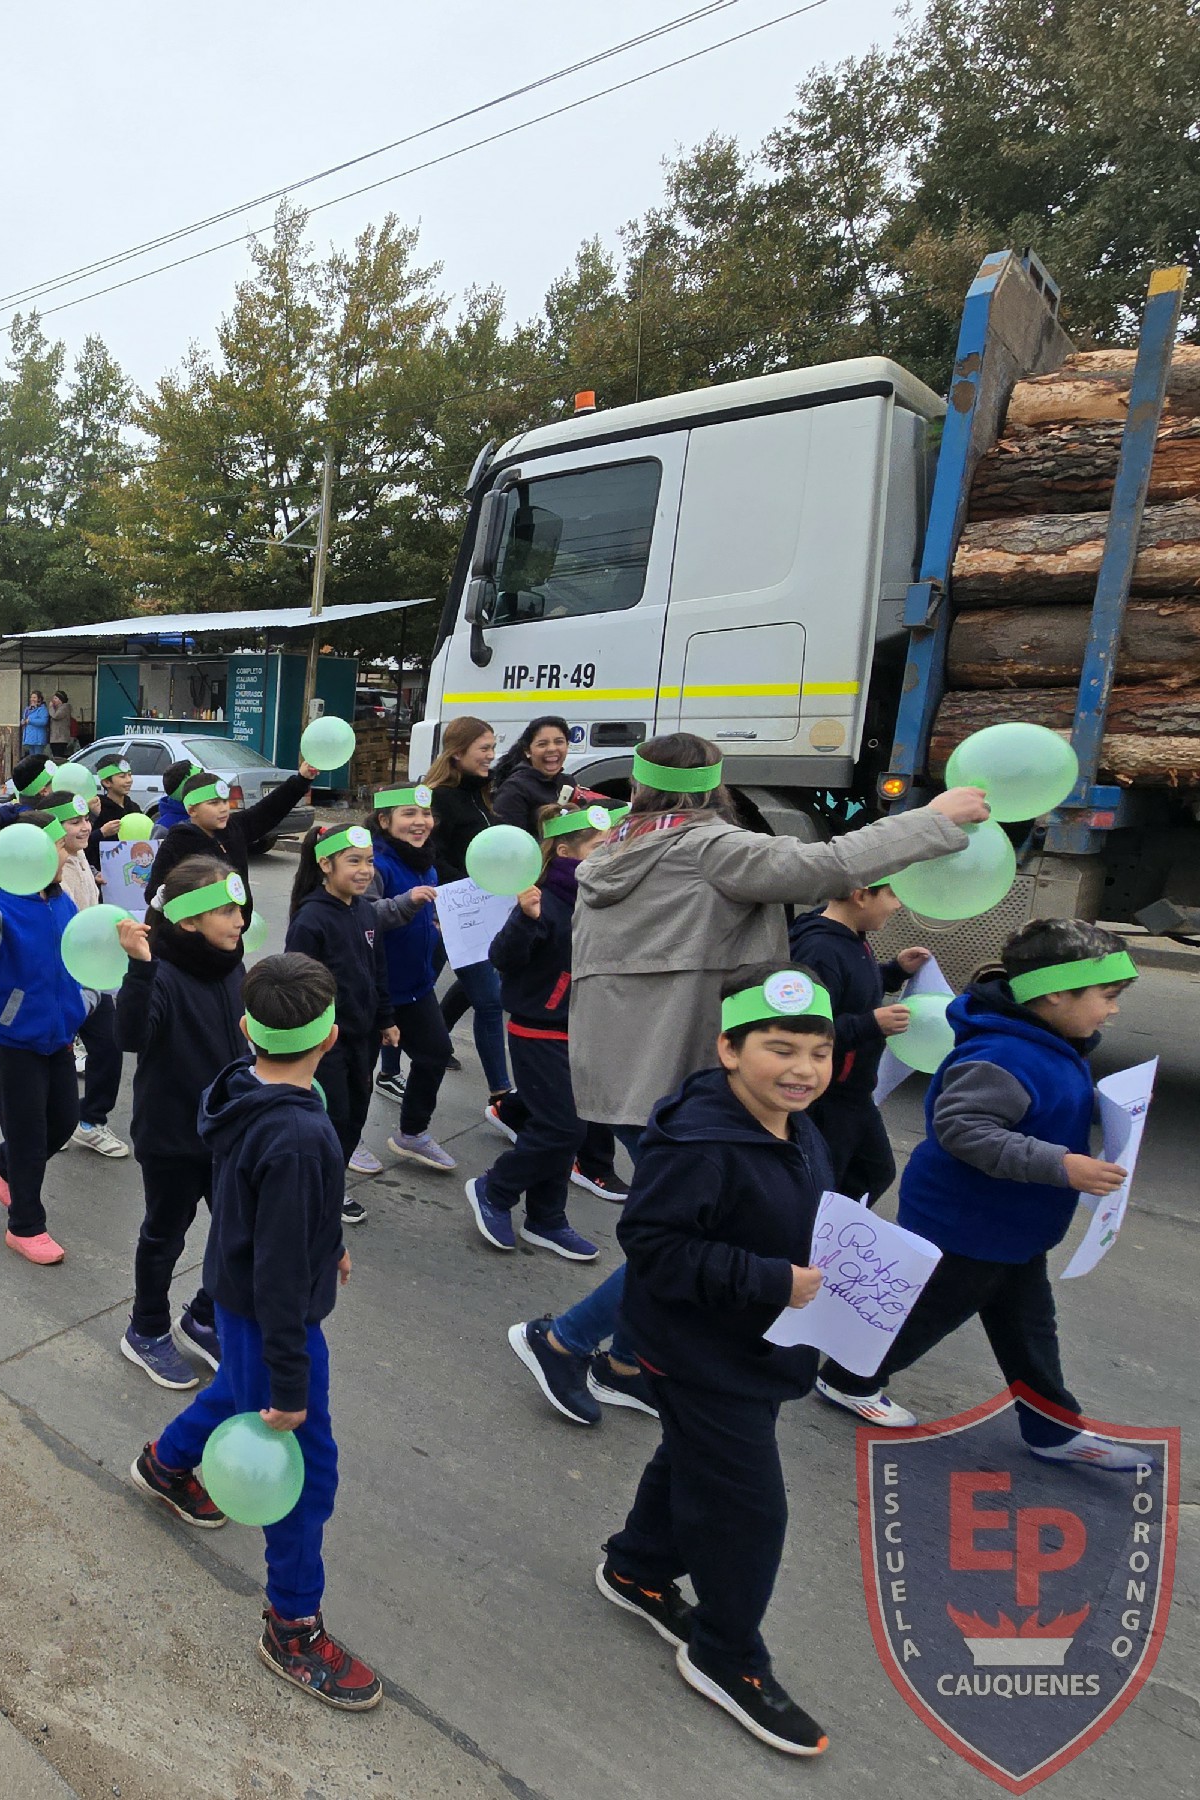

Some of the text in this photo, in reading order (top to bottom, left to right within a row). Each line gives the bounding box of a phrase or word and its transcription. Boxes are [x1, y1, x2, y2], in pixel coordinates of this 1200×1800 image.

[236, 667, 263, 675] COMPLETO
[142, 725, 164, 735] TRUCK
[233, 727, 254, 735] BEBIDAS
